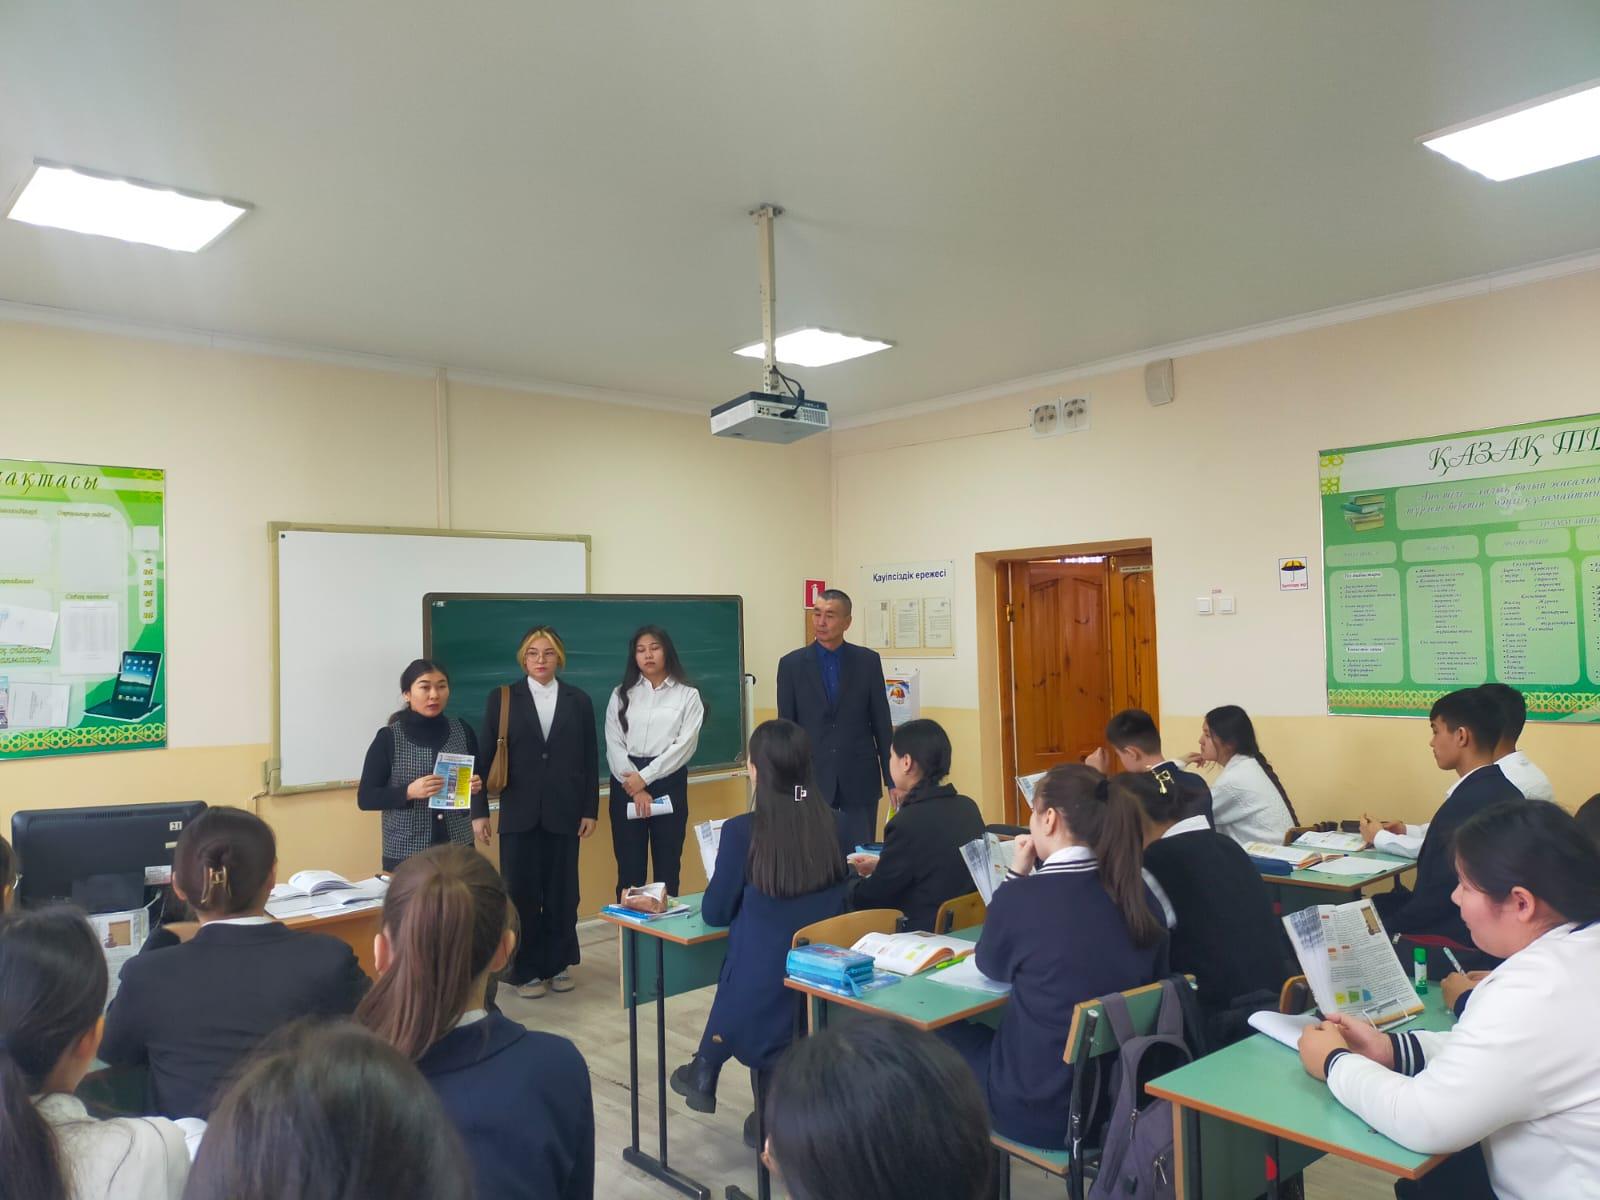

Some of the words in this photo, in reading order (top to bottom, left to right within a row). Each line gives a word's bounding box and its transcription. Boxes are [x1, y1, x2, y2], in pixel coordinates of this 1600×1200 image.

[1428, 433, 1544, 477] ҚАЗАҚ
[0, 471, 99, 495] ақтасы
[873, 570, 914, 583] Қауіпсіздік
[915, 569, 946, 581] ережесі
